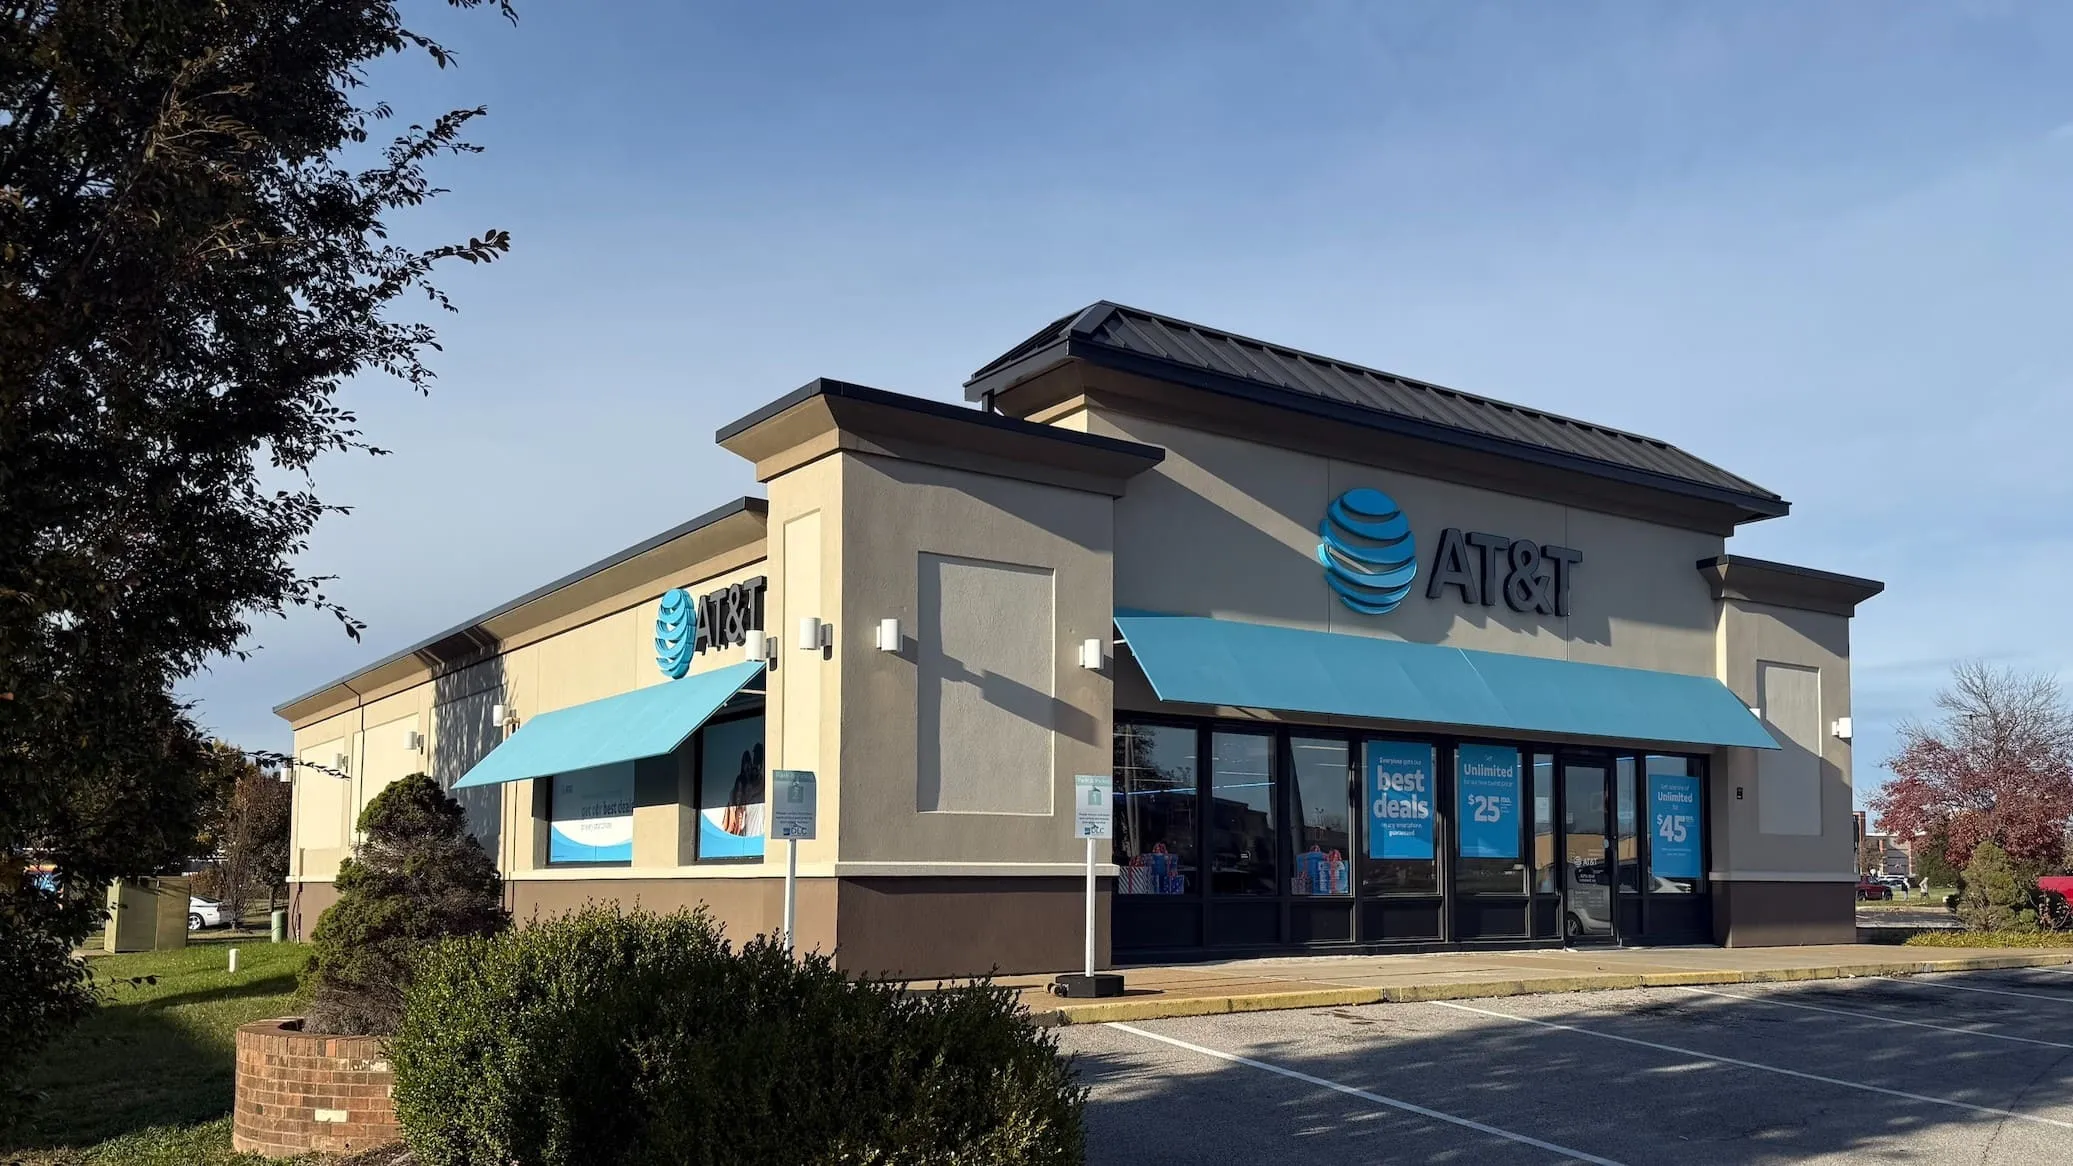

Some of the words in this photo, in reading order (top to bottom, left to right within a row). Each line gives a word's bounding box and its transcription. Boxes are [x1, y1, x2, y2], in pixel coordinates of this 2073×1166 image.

[1426, 528, 1583, 617] AT&T
[695, 576, 767, 655] AT&T
[1377, 765, 1425, 792] best
[1463, 763, 1513, 778] Unlimited
[1373, 792, 1429, 819] deals
[1468, 794, 1501, 823] $25
[1657, 791, 1693, 803] Unlimited
[1656, 814, 1687, 842] $45
